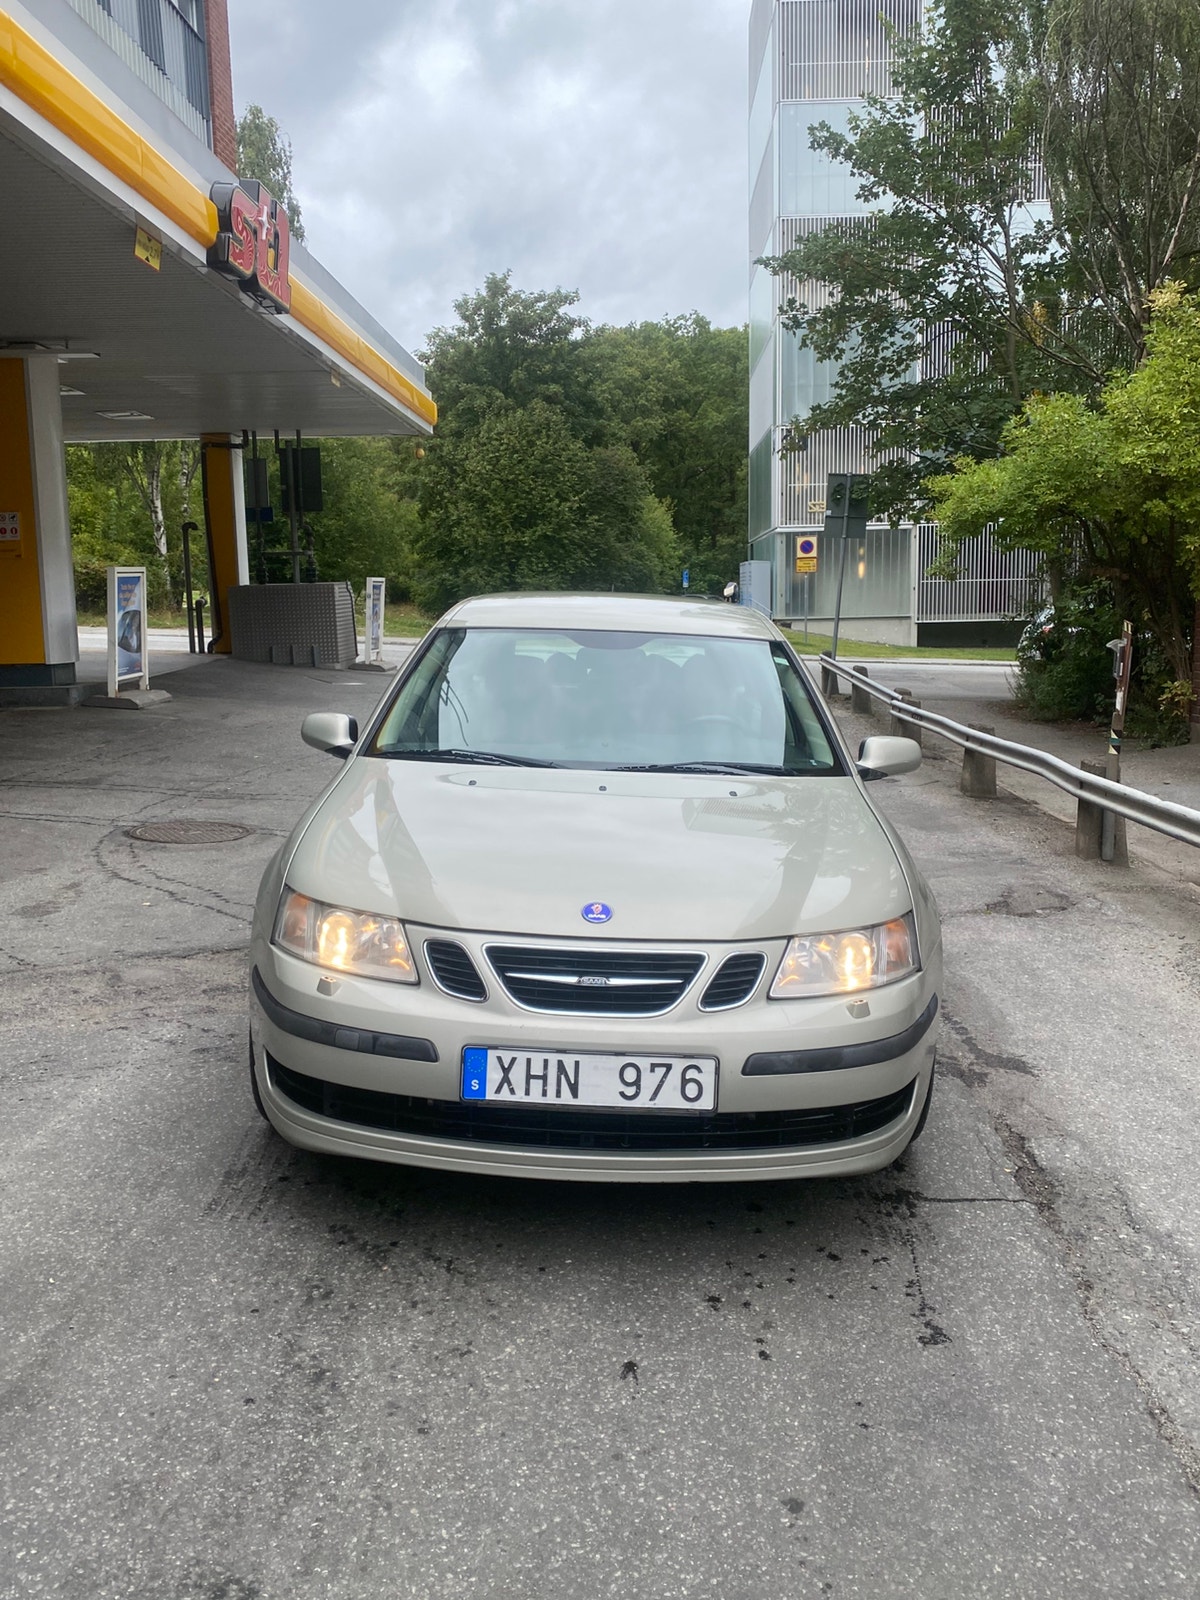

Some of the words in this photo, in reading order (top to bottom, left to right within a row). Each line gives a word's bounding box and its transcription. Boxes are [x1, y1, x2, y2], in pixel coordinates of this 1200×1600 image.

[471, 1079, 479, 1091] S
[493, 1055, 580, 1099] XHN
[618, 1062, 704, 1103] 976
